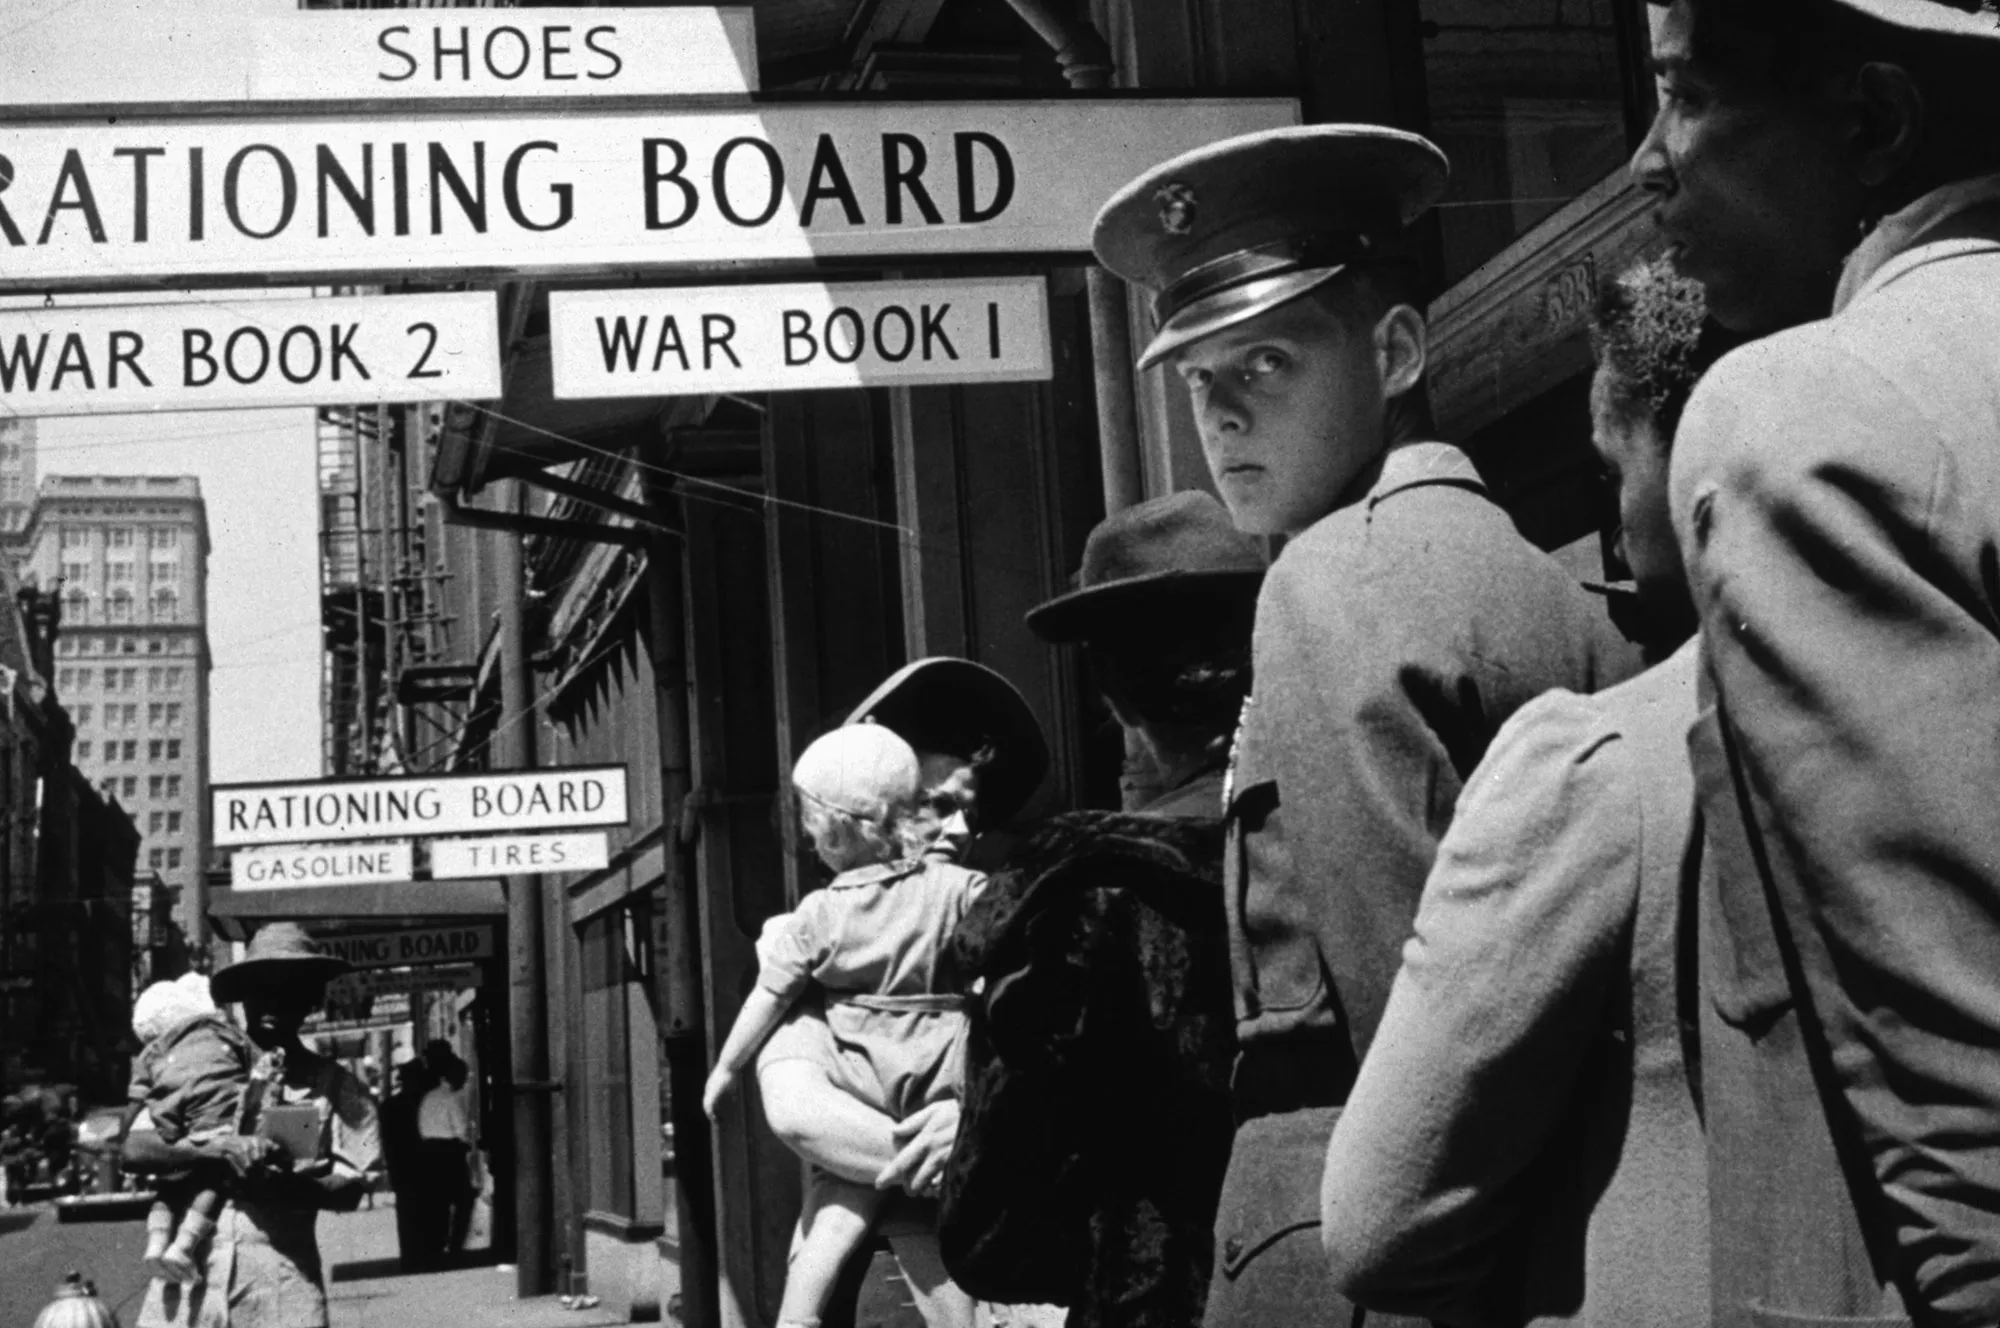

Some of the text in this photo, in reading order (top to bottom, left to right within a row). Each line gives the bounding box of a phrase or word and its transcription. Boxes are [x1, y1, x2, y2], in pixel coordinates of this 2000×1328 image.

[377, 25, 623, 82] SHOES
[642, 131, 1015, 231] BOARD
[0, 321, 441, 393] WAR BOOK 2
[595, 313, 743, 373] WAR
[782, 303, 960, 367] BOOK
[229, 779, 606, 832] RATIONING BOARD
[247, 852, 392, 880] GASOLINE
[470, 841, 565, 866] TIRES
[400, 931, 479, 959] BOARD
